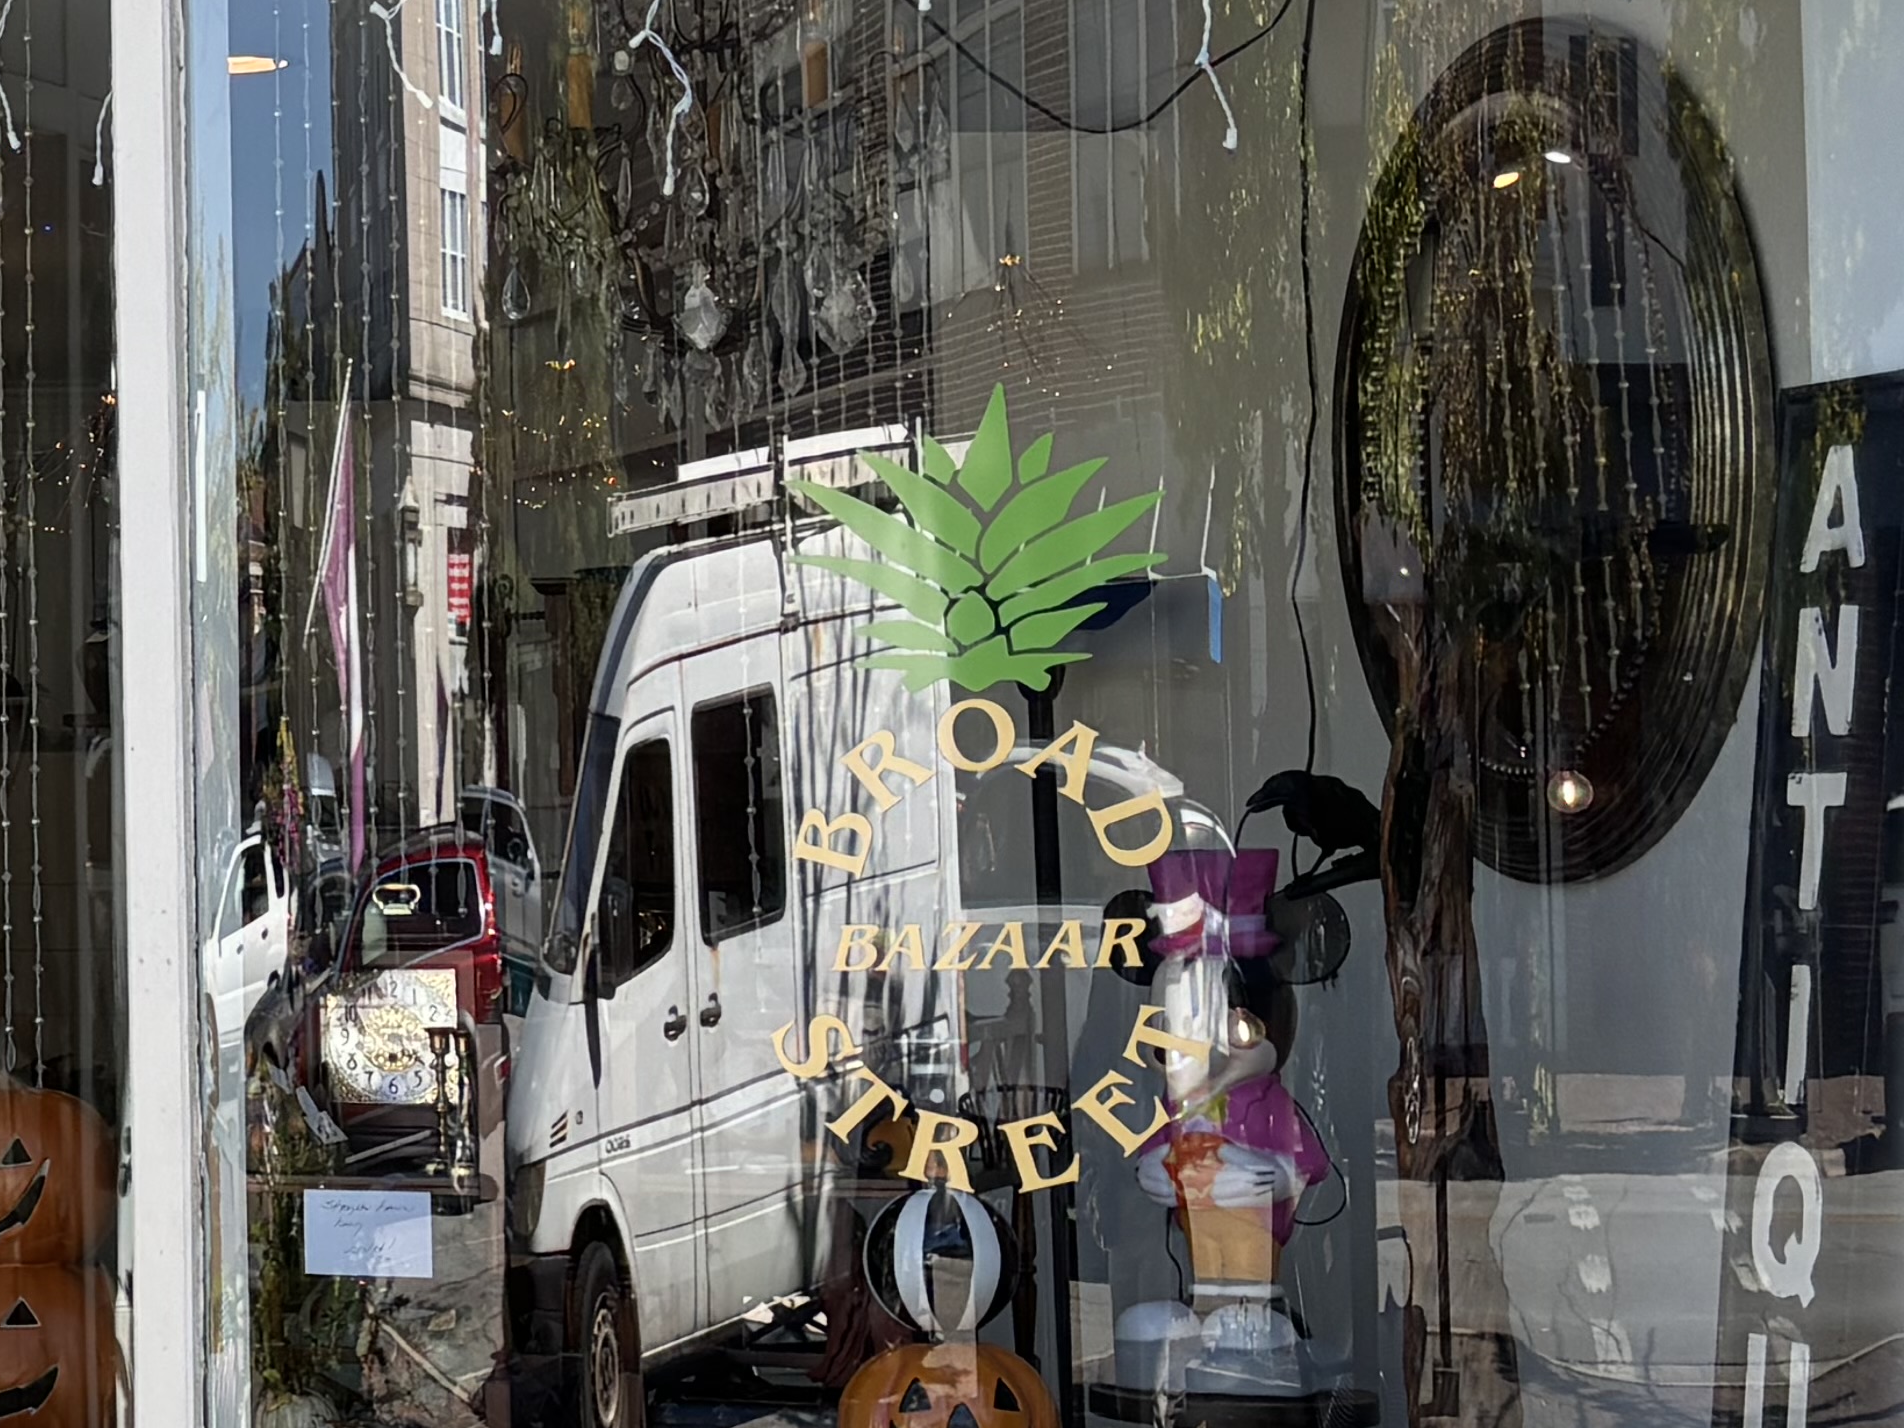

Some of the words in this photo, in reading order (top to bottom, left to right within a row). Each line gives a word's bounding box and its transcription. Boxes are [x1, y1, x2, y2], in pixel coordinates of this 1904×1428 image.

[794, 698, 1173, 879] BROAD
[832, 917, 1146, 972] BAZAAR
[772, 1004, 1212, 1194] STREET
